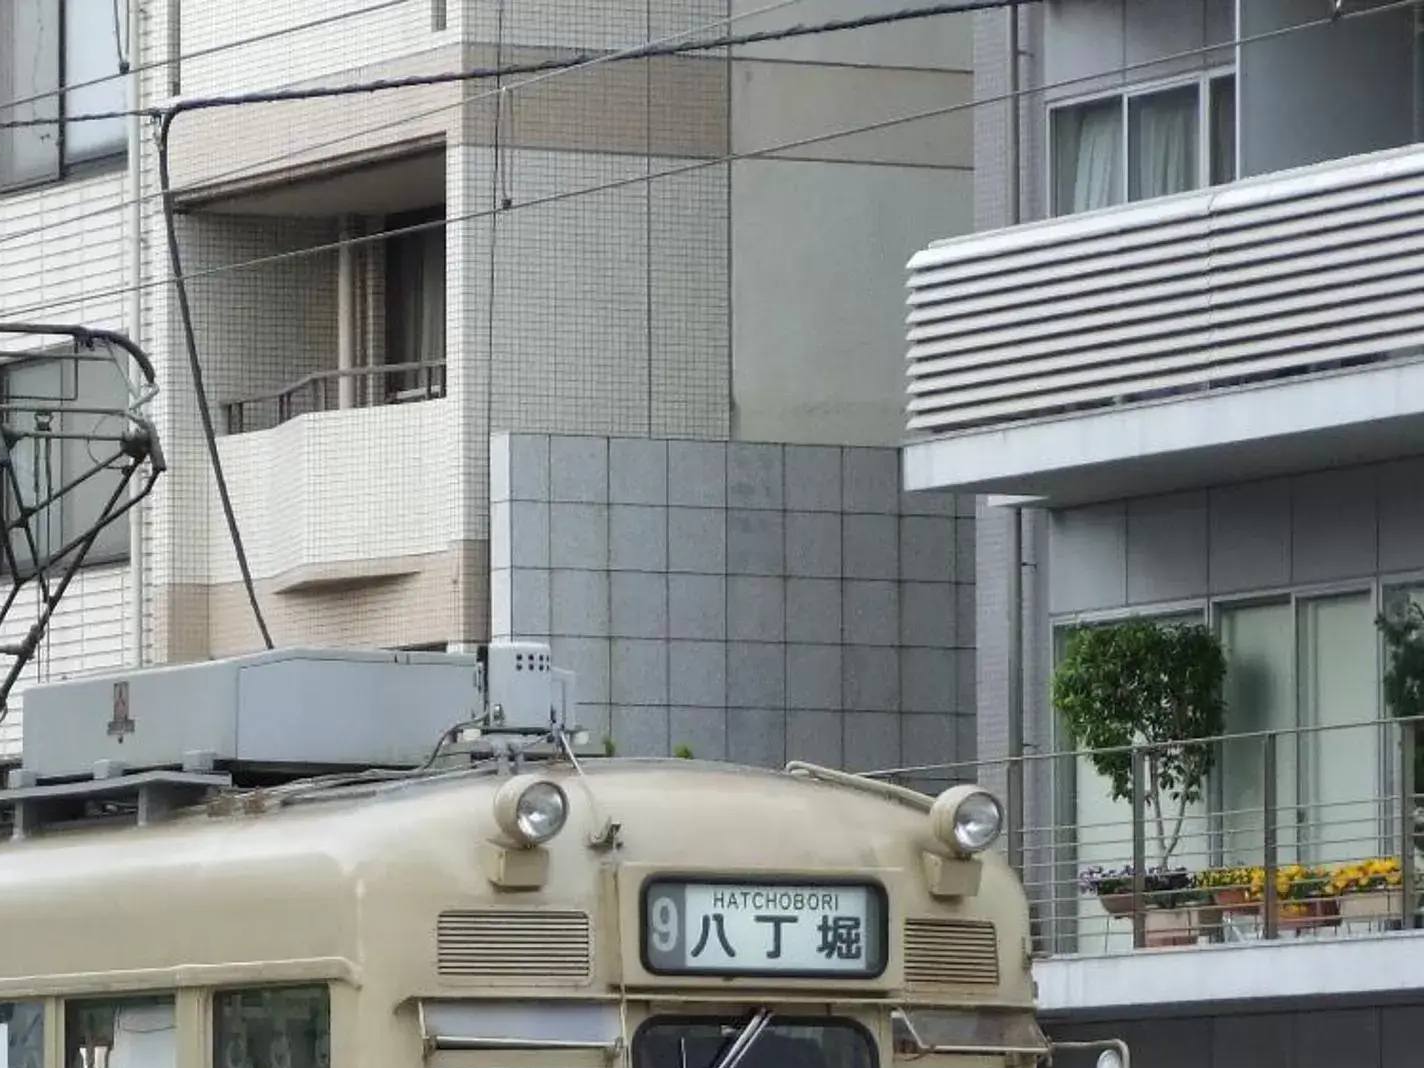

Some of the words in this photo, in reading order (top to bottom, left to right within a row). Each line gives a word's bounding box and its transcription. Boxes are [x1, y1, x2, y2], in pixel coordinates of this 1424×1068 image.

[652, 896, 677, 951] 9
[713, 891, 839, 911] HATCHOBORI
[690, 913, 862, 959] 八丁堀
